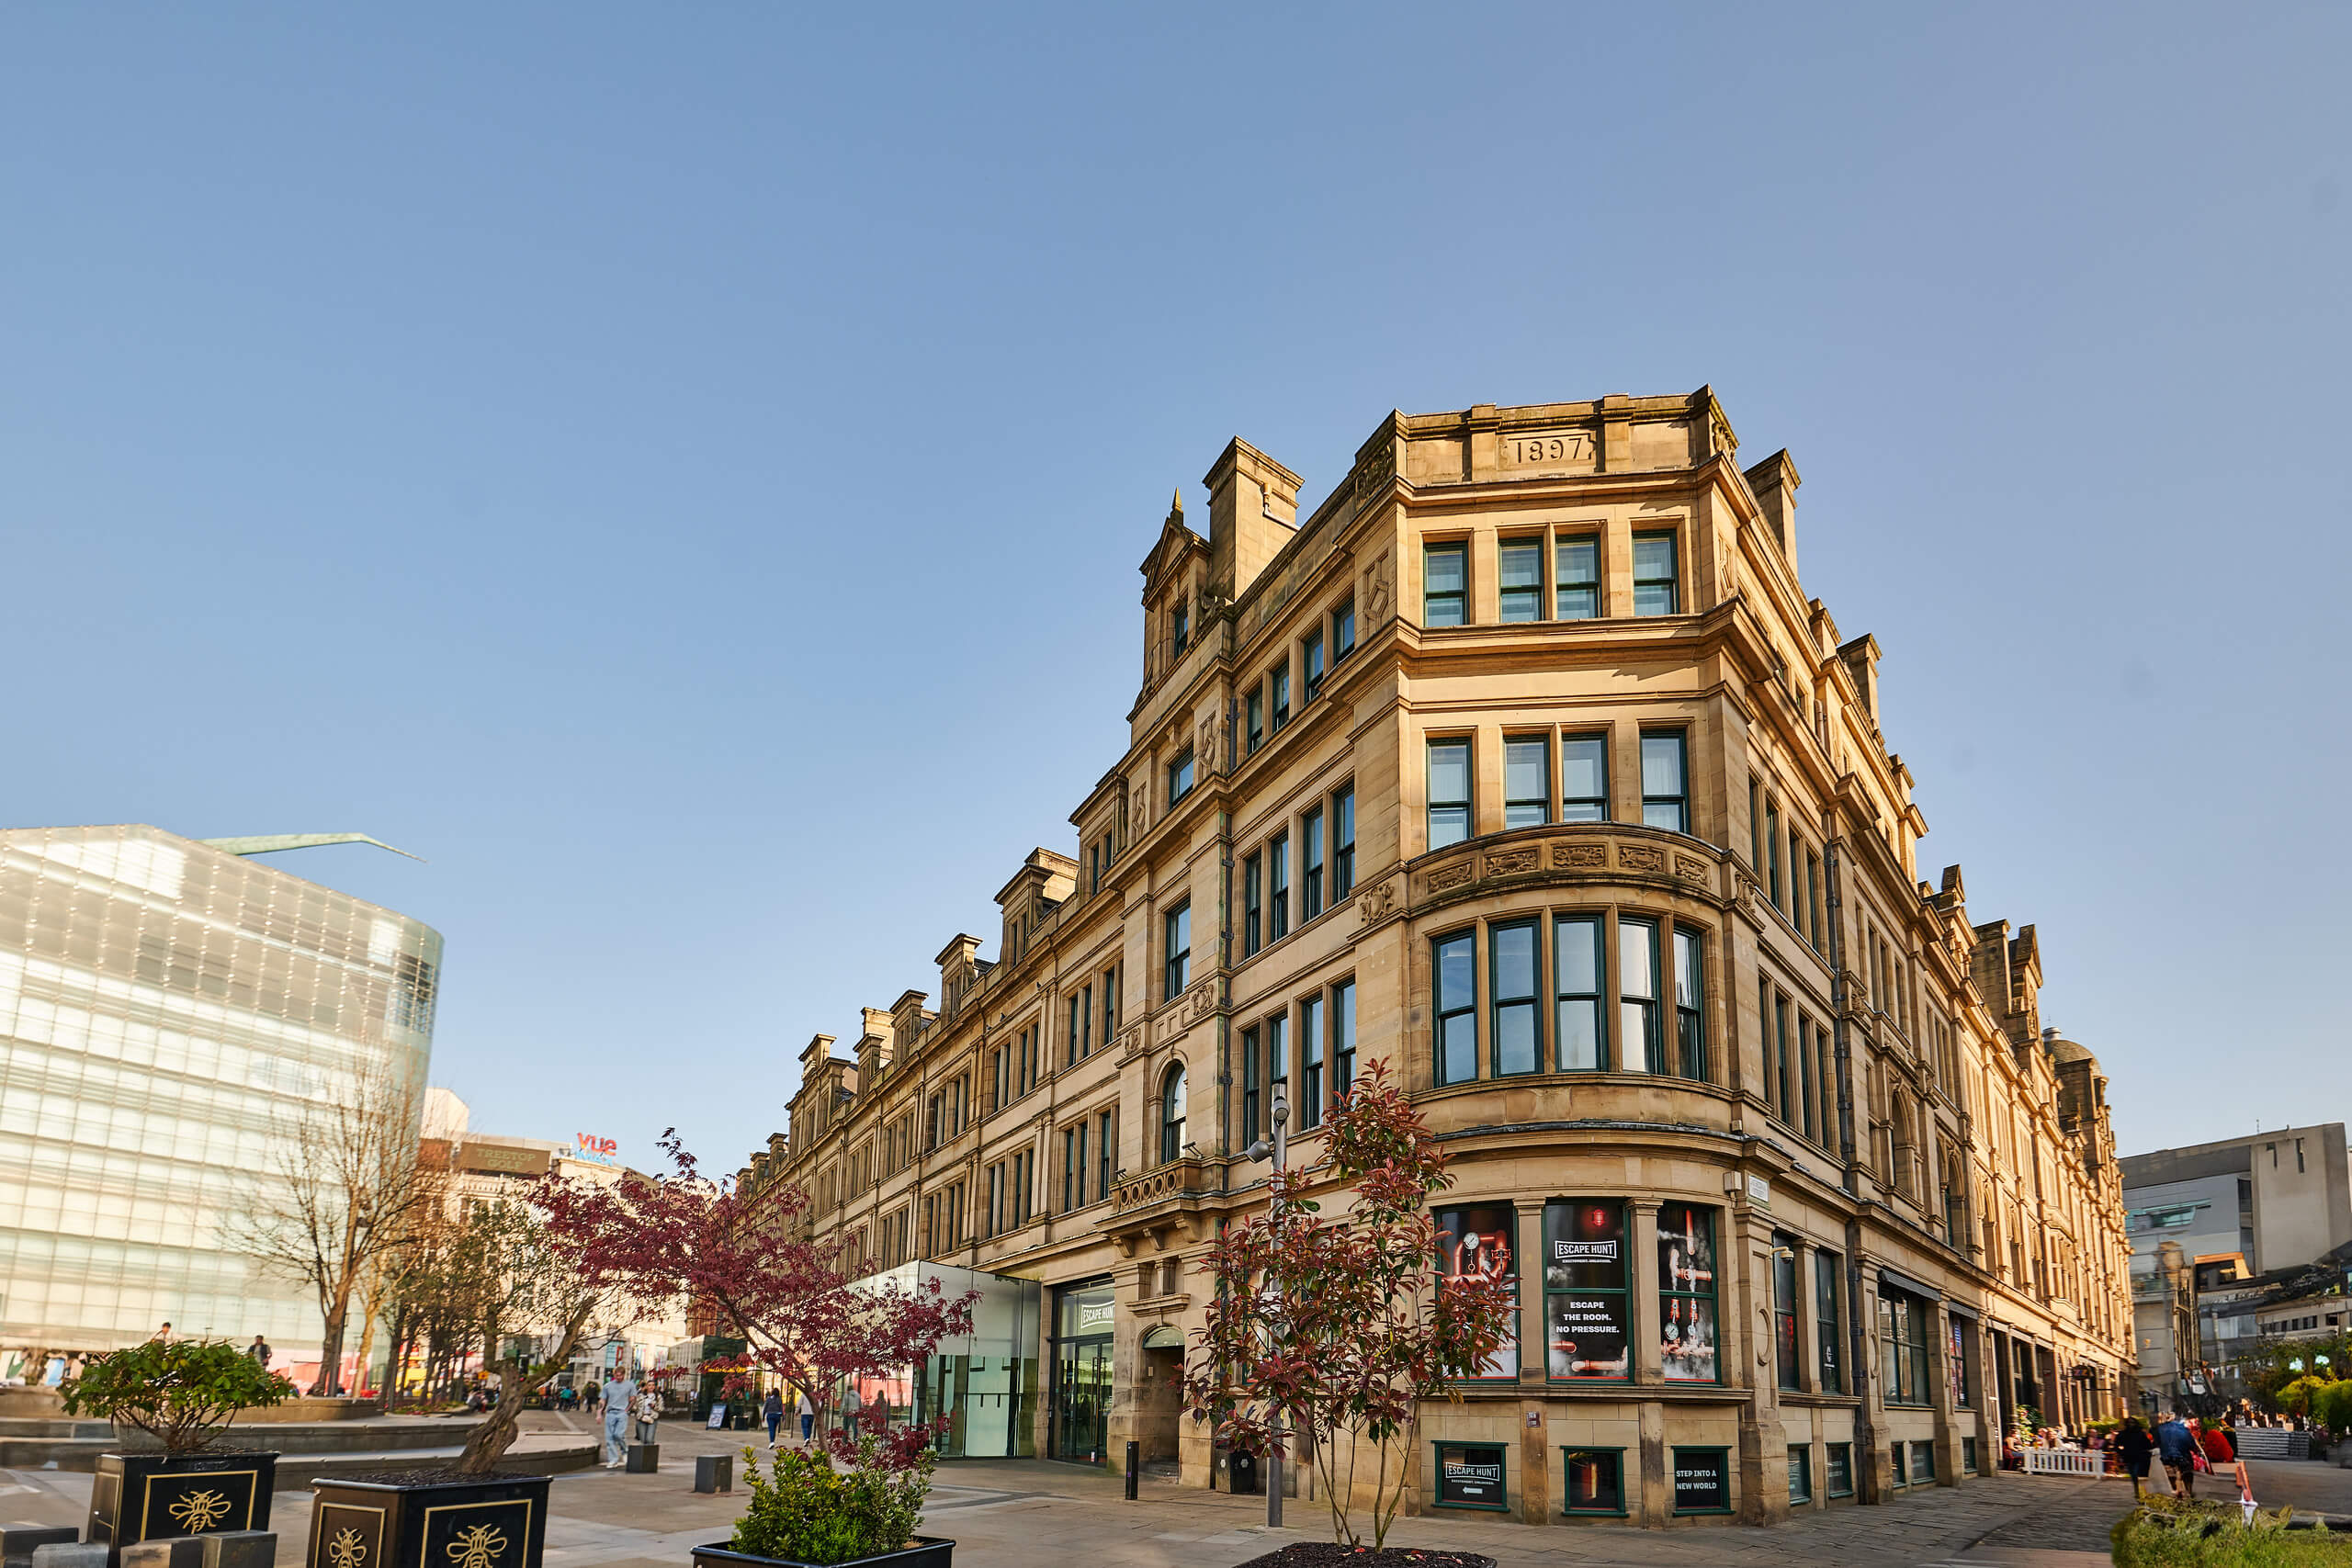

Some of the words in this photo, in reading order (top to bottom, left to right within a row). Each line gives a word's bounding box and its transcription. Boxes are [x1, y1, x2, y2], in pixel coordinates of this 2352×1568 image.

[1518, 437, 1582, 463] 1897
[477, 1148, 537, 1161] TREETOP
[487, 1158, 523, 1169] GOLF
[1558, 1244, 1590, 1255] ESCAPE
[1590, 1244, 1613, 1255] HUNT
[1570, 1301, 1605, 1309] ESCAPE
[1083, 1308, 1102, 1324] ESCAPE
[1102, 1304, 1115, 1319] HUN
[1448, 1465, 1476, 1475] ESCAPE
[1476, 1467, 1497, 1478] HUNT
